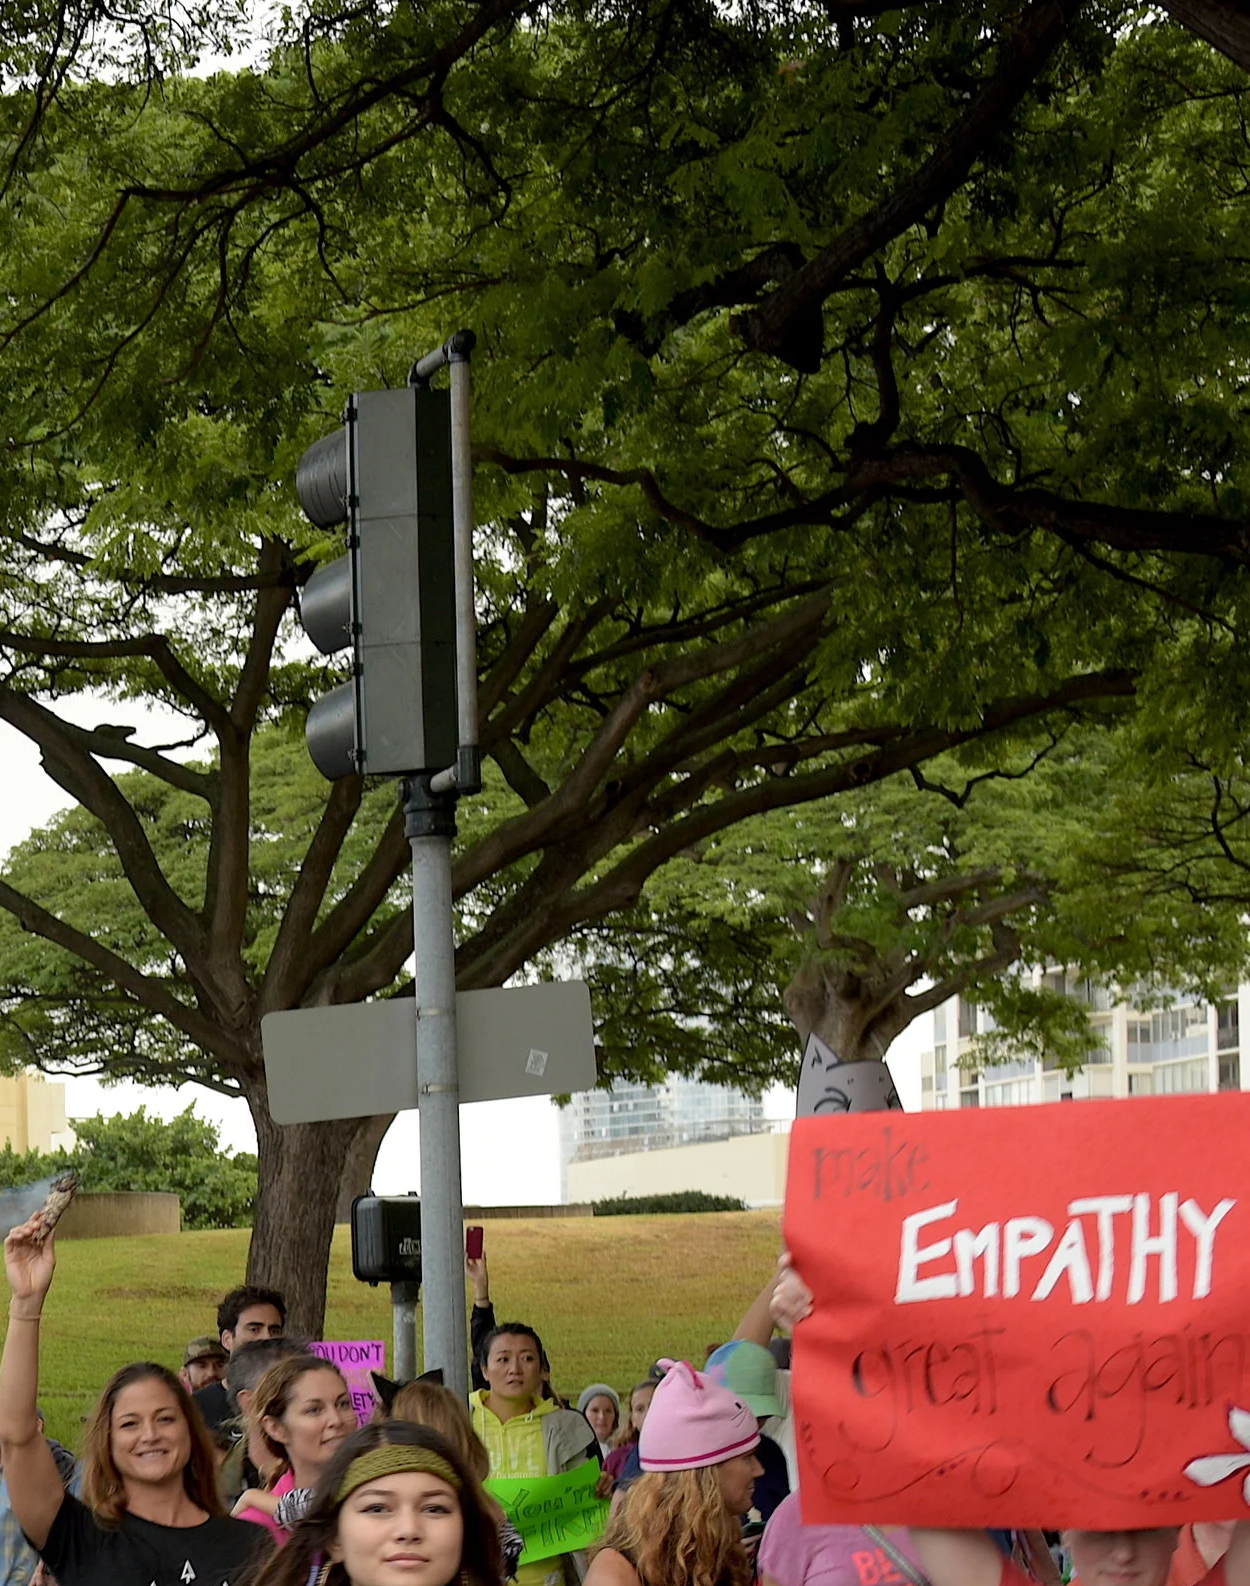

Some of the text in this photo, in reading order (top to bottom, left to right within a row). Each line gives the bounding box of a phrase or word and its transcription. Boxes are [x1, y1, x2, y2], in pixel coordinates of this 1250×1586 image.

[812, 1126, 932, 1202] make
[894, 1191, 1237, 1306] EMPATHY
[338, 1343, 382, 1363] DON'T
[835, 1312, 1249, 1469] great again
